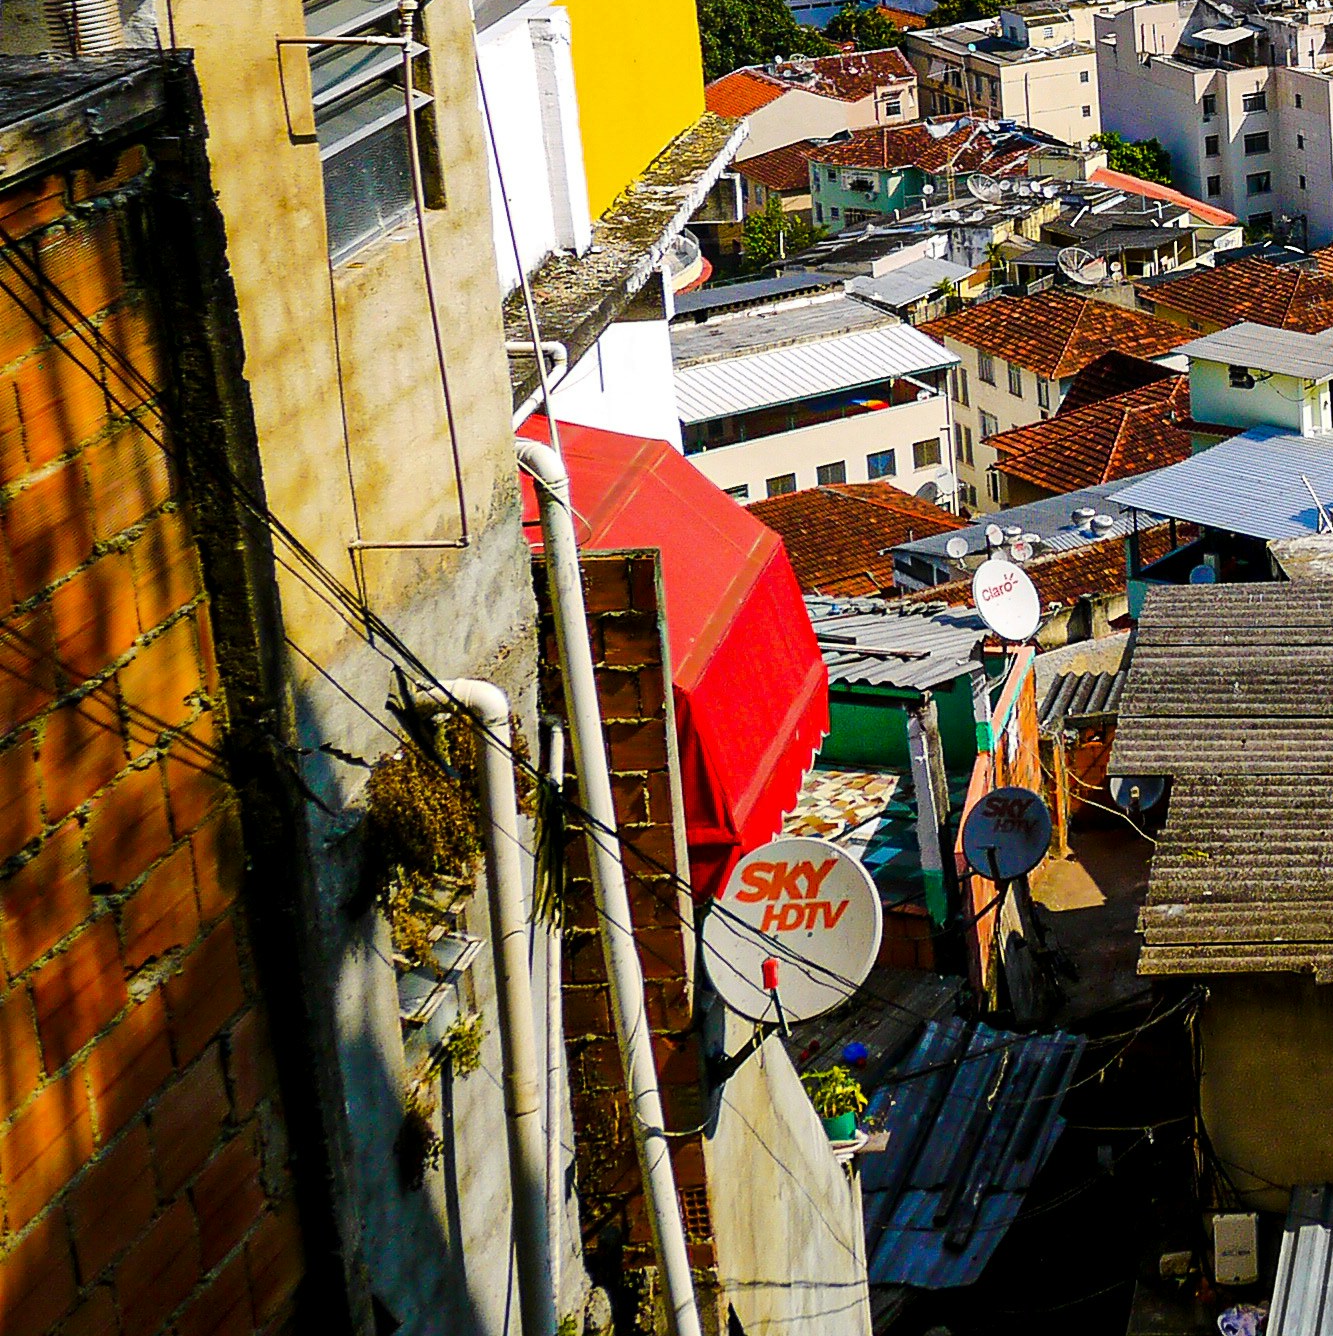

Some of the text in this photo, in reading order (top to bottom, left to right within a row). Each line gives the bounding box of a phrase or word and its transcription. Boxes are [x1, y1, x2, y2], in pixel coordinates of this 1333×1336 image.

[982, 578, 1014, 601] Claro
[982, 796, 1035, 818] SKY
[735, 858, 838, 903] SKY
[761, 900, 849, 933] HDTV
